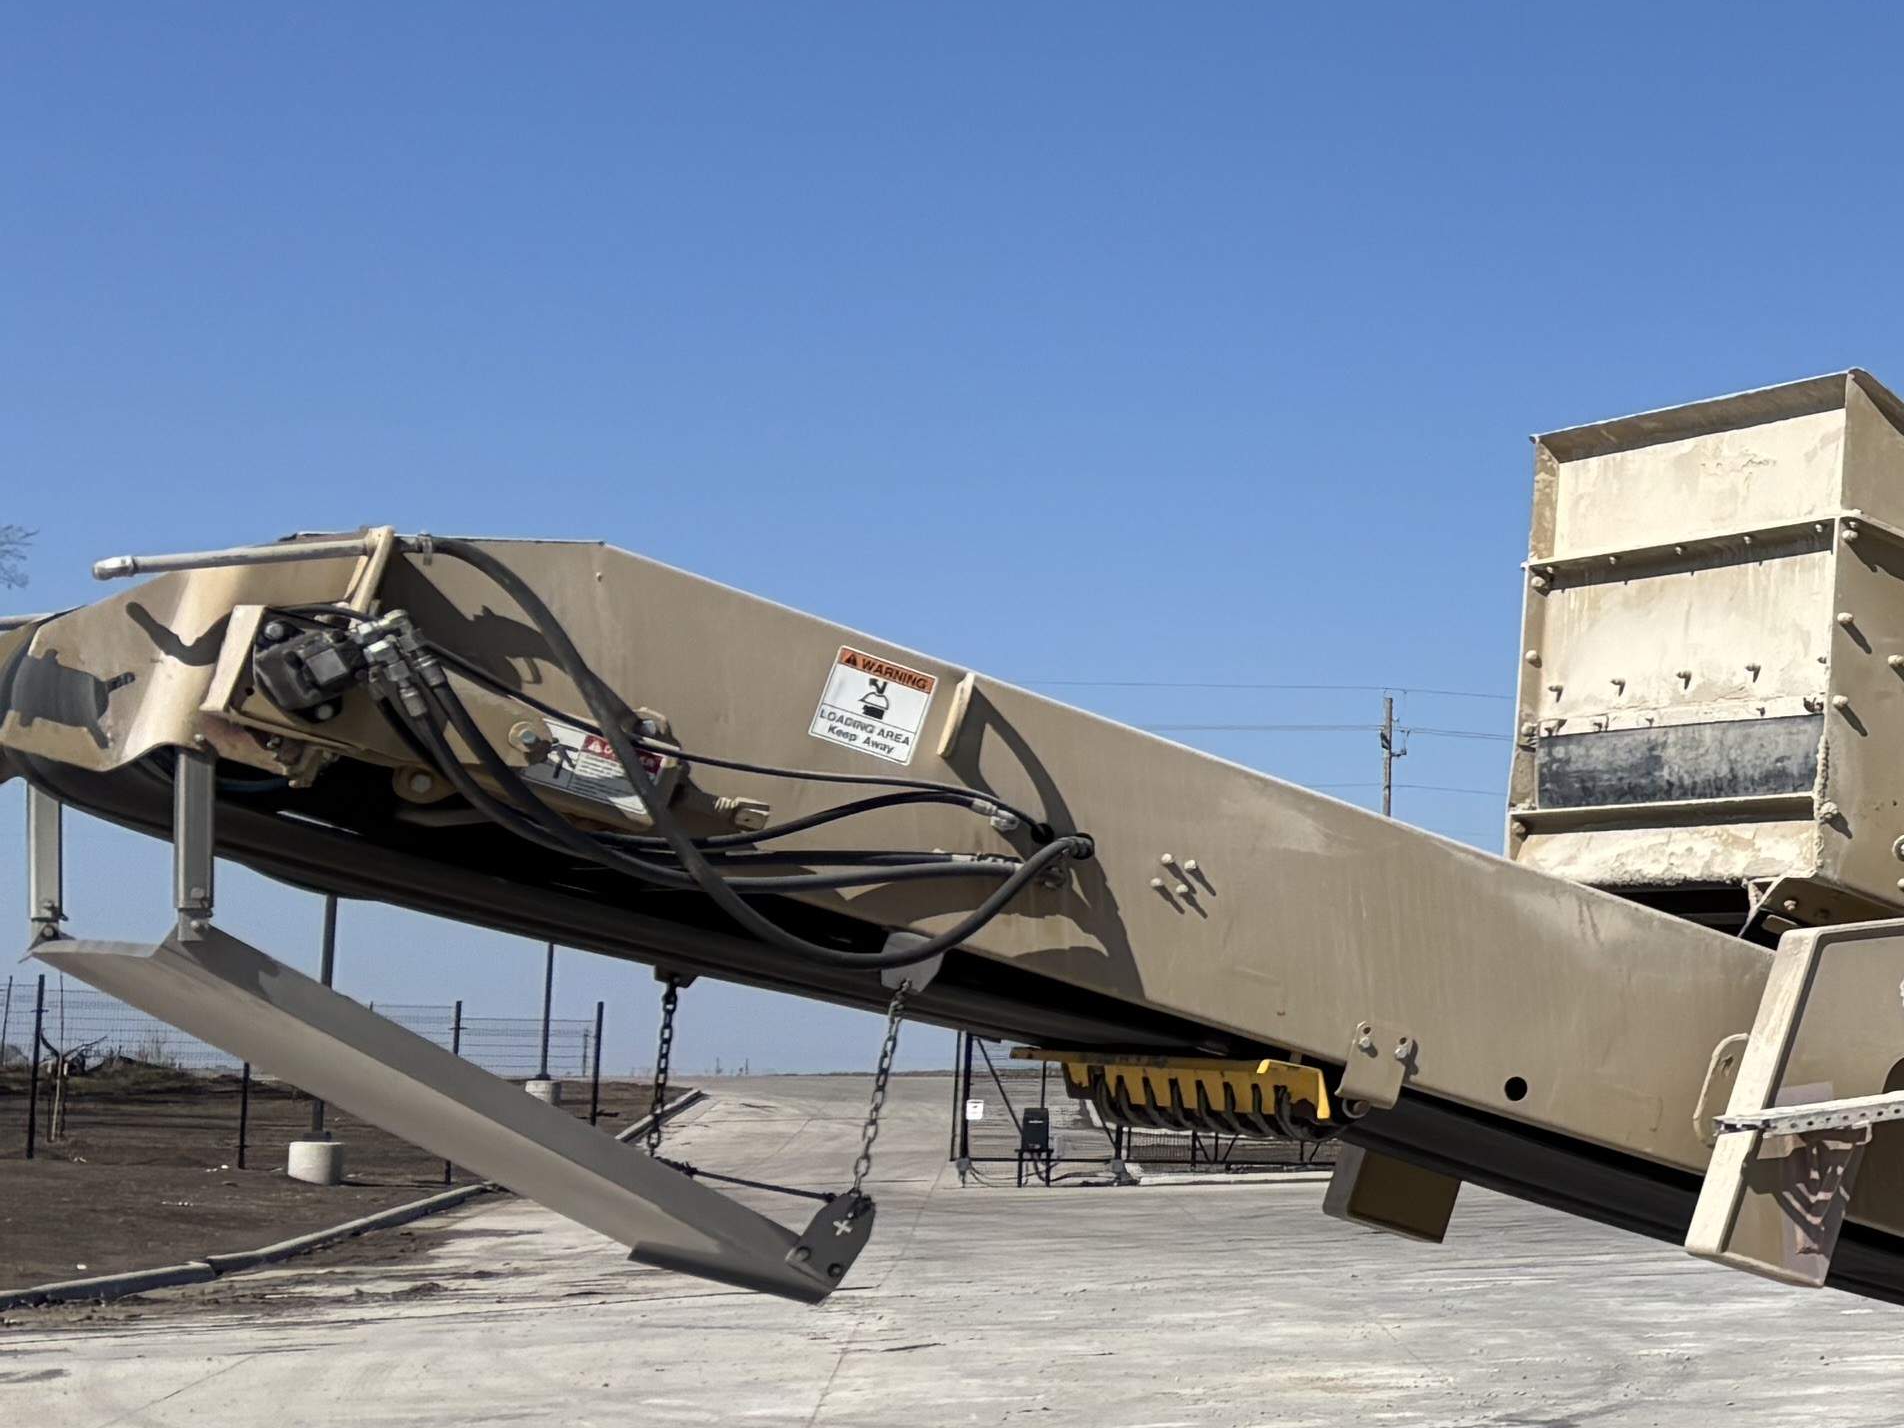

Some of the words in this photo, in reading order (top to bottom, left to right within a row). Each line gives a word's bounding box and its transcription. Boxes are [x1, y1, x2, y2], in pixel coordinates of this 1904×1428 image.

[861, 658, 927, 690] WARNING
[819, 709, 875, 734] LOADING
[877, 728, 910, 746] AREA
[828, 724, 857, 742] Keep
[863, 736, 895, 754] Away
